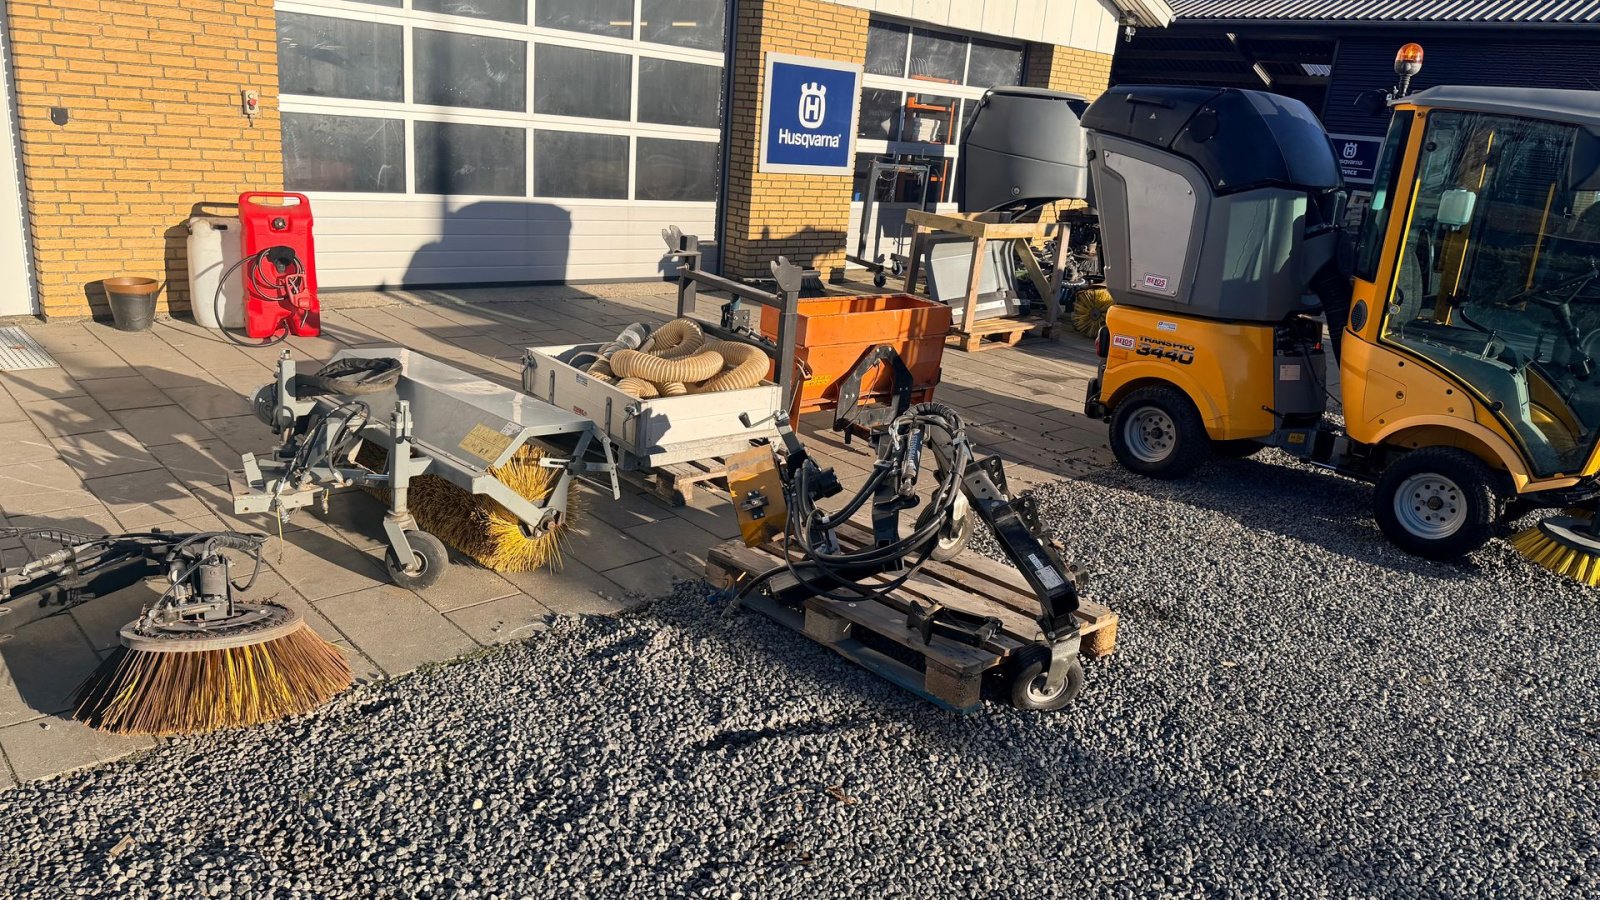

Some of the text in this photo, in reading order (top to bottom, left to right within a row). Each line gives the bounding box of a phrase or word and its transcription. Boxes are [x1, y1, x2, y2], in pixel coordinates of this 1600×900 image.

[778, 128, 841, 148] Husqvarna
[1146, 276, 1166, 288] BELOS
[1115, 337, 1132, 347] BELOS
[1136, 342, 1194, 364] 3440
